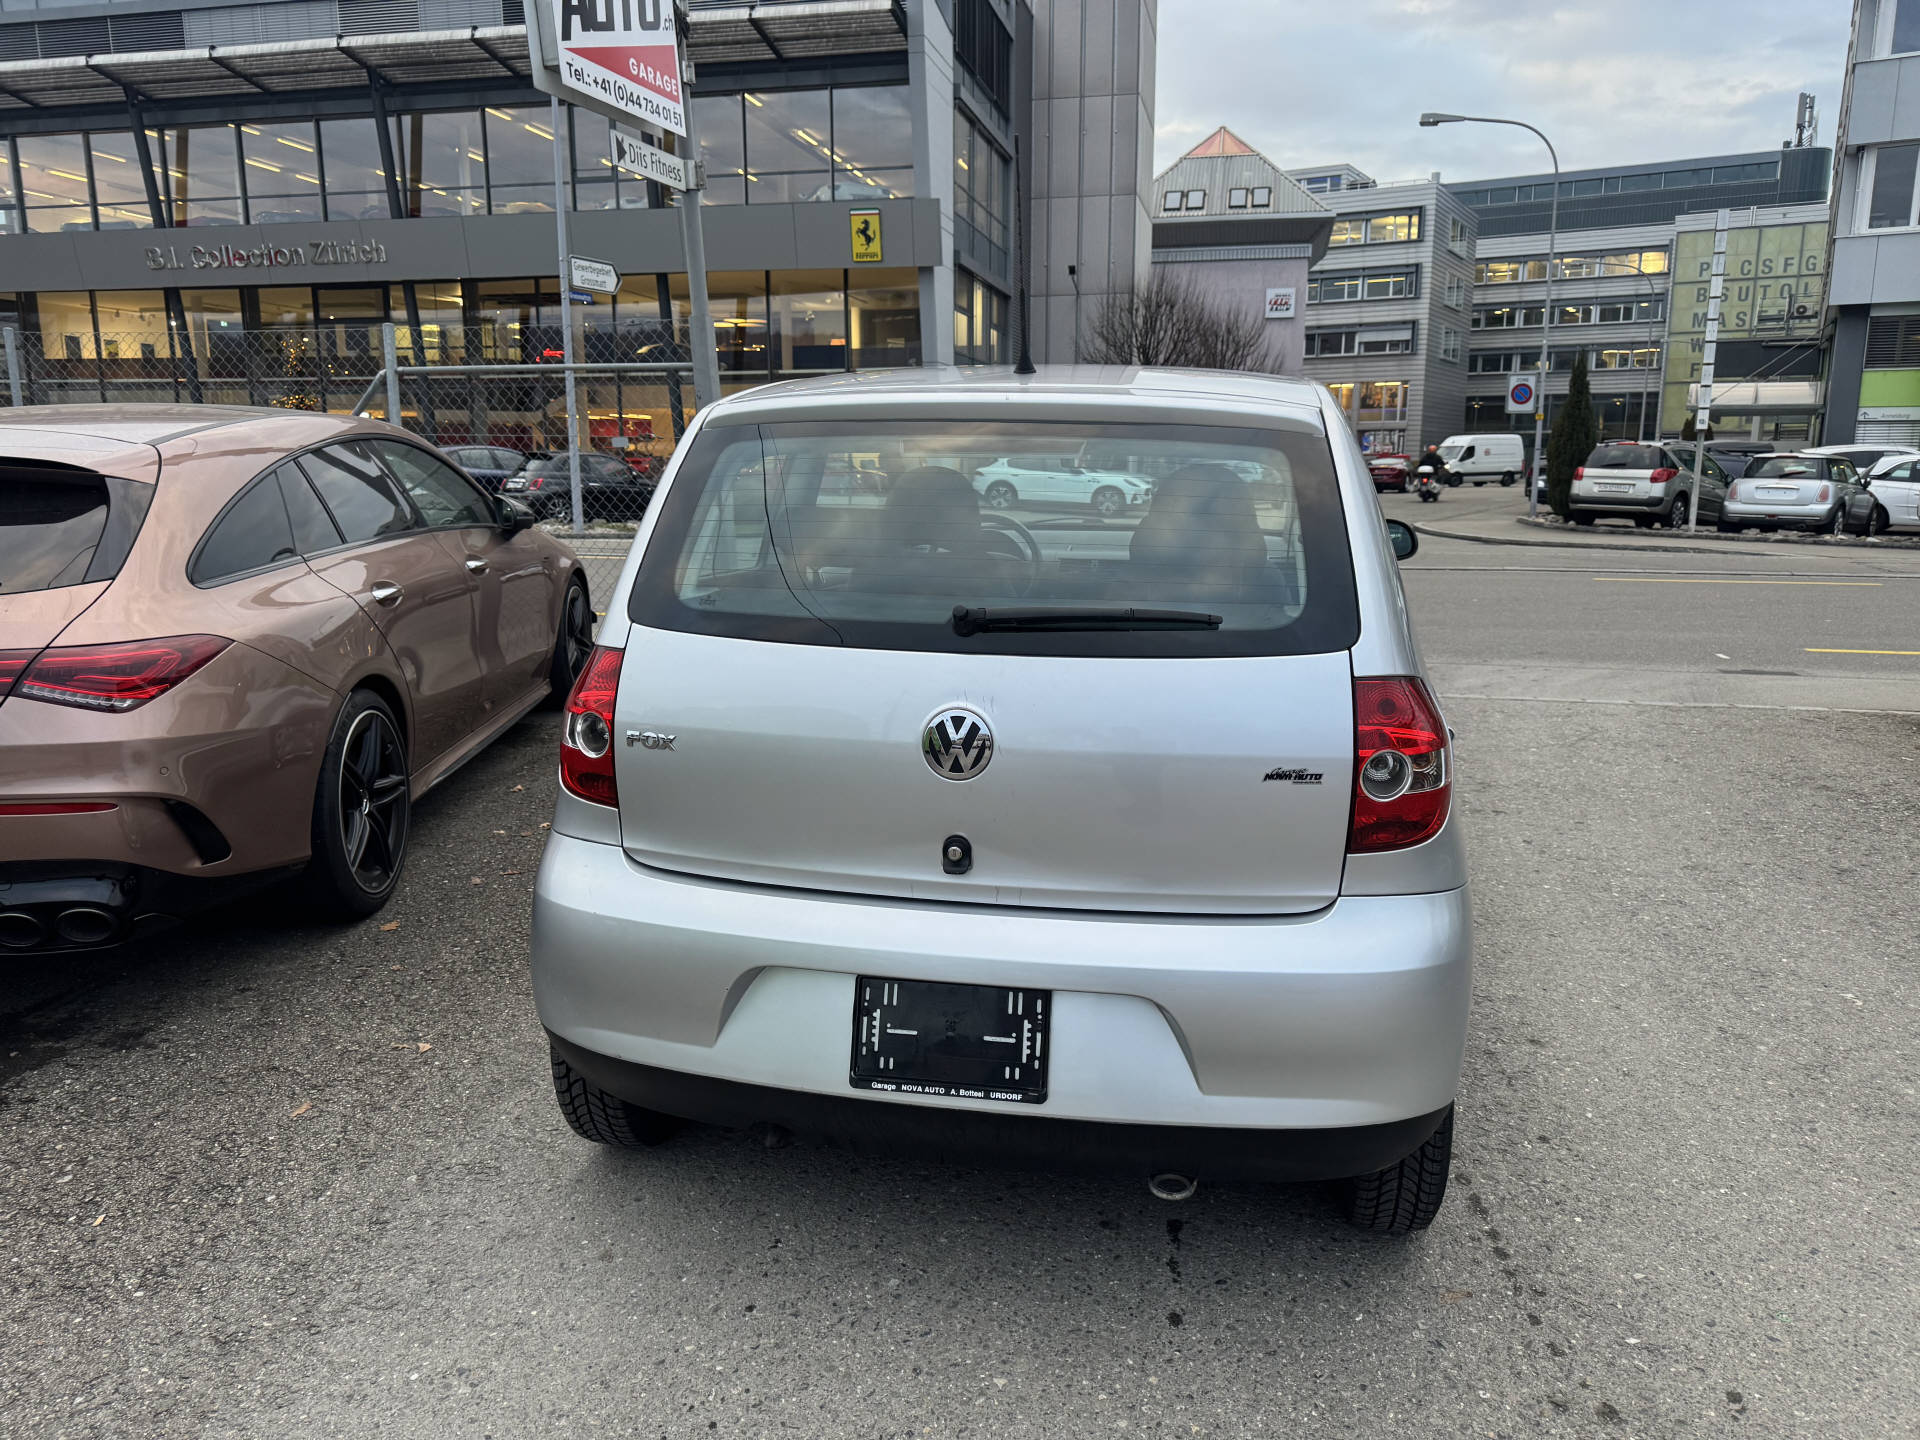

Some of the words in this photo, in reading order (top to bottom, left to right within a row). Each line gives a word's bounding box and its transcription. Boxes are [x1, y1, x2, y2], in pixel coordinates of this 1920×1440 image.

[629, 57, 677, 95] GARAGE
[566, 62, 592, 87] Tel.:
[593, 74, 612, 96] +41
[644, 99, 661, 117] 734
[662, 106, 672, 123] 01
[673, 109, 682, 128] 51
[628, 143, 647, 169] Diis
[650, 150, 682, 183] Fitness
[191, 243, 305, 269] Collection
[309, 238, 387, 265] Zürich
[626, 730, 677, 751] FOX
[1294, 773, 1323, 781] AUTO
[871, 1081, 896, 1091] Garage
[901, 1084, 923, 1093] NOVA
[924, 1086, 945, 1094] AUTO
[950, 1088, 958, 1096] A.
[990, 1092, 1023, 1101] URDORF
